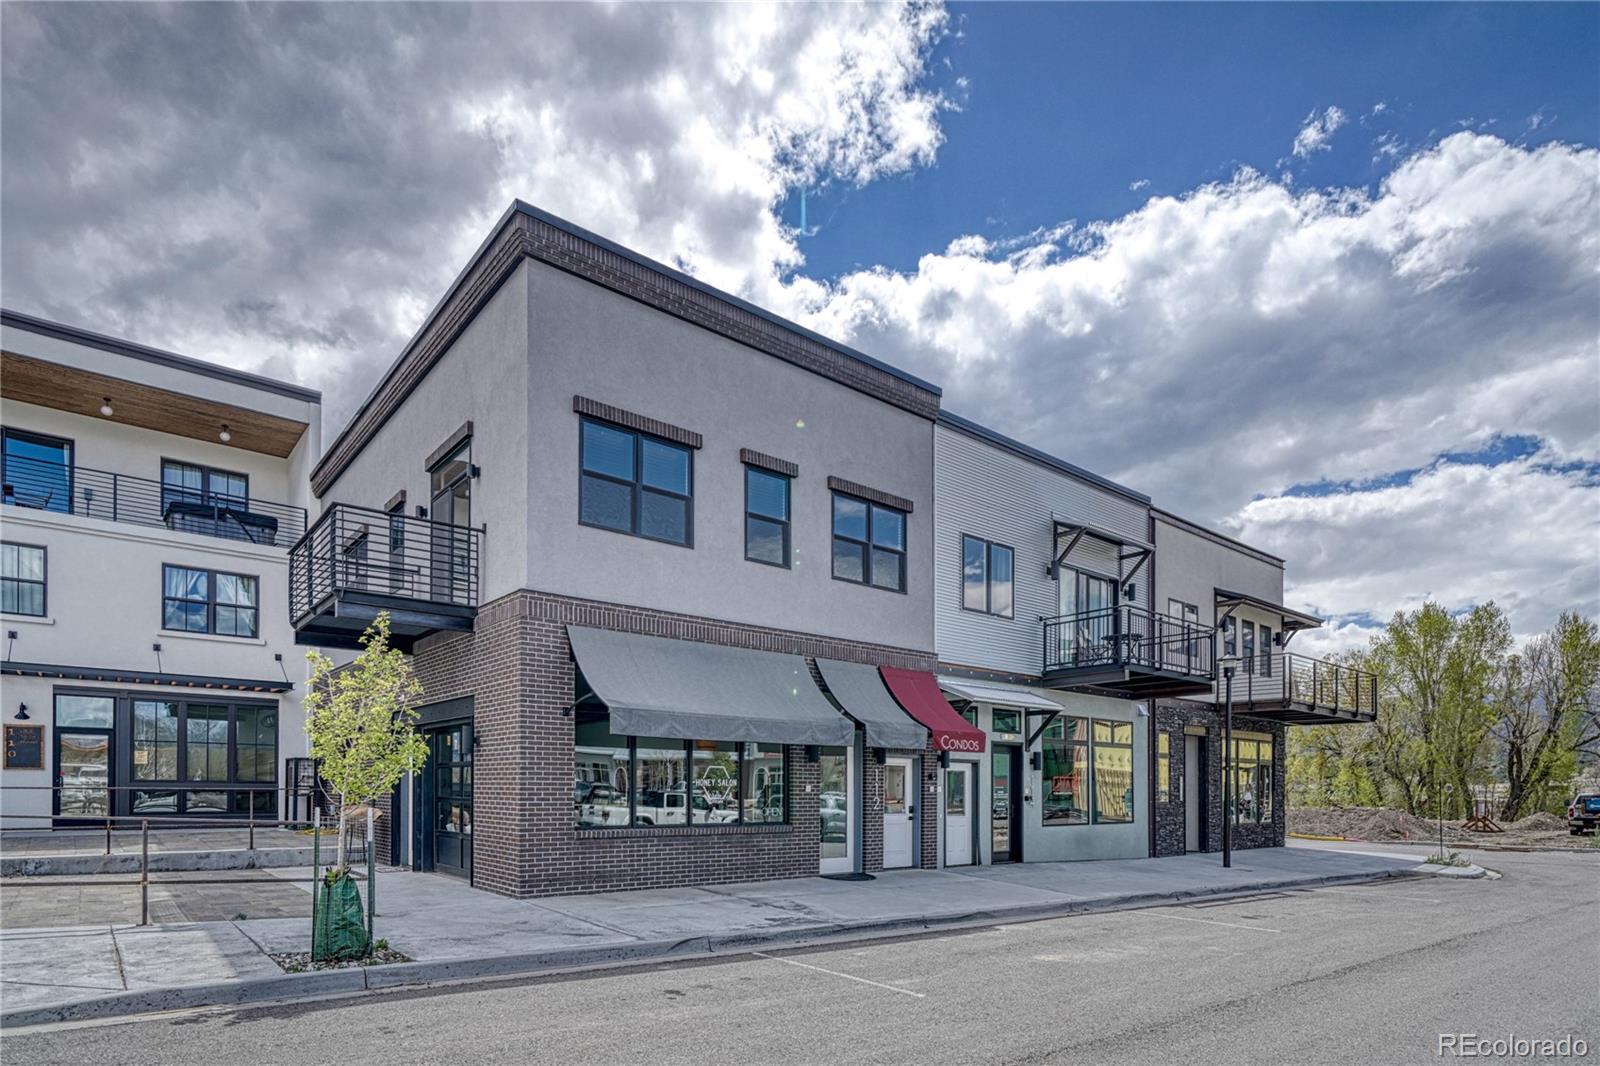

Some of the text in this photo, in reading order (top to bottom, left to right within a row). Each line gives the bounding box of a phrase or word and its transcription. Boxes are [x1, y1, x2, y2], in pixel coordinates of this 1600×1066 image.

[940, 734, 980, 752] CONDOS
[695, 778, 738, 788] HONEY SALON
[872, 768, 881, 810] 112
[762, 807, 783, 817] OPEN
